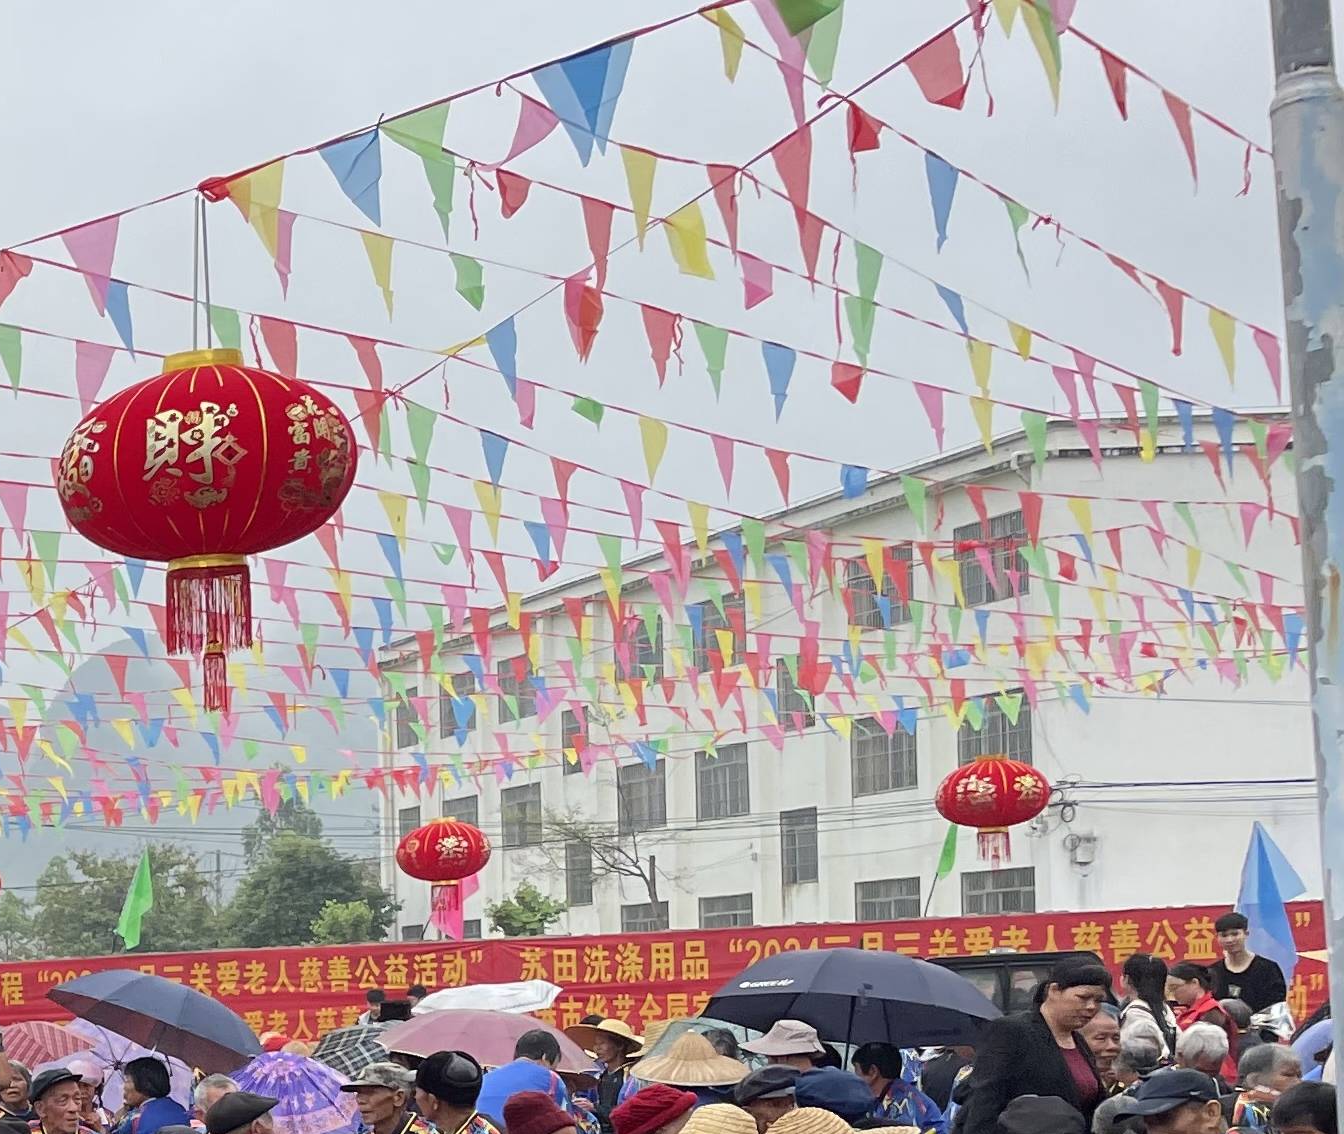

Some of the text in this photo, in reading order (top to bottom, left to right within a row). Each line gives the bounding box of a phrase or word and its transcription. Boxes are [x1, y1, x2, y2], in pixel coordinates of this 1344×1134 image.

[519, 939, 710, 984] 苏田洗涤用品
